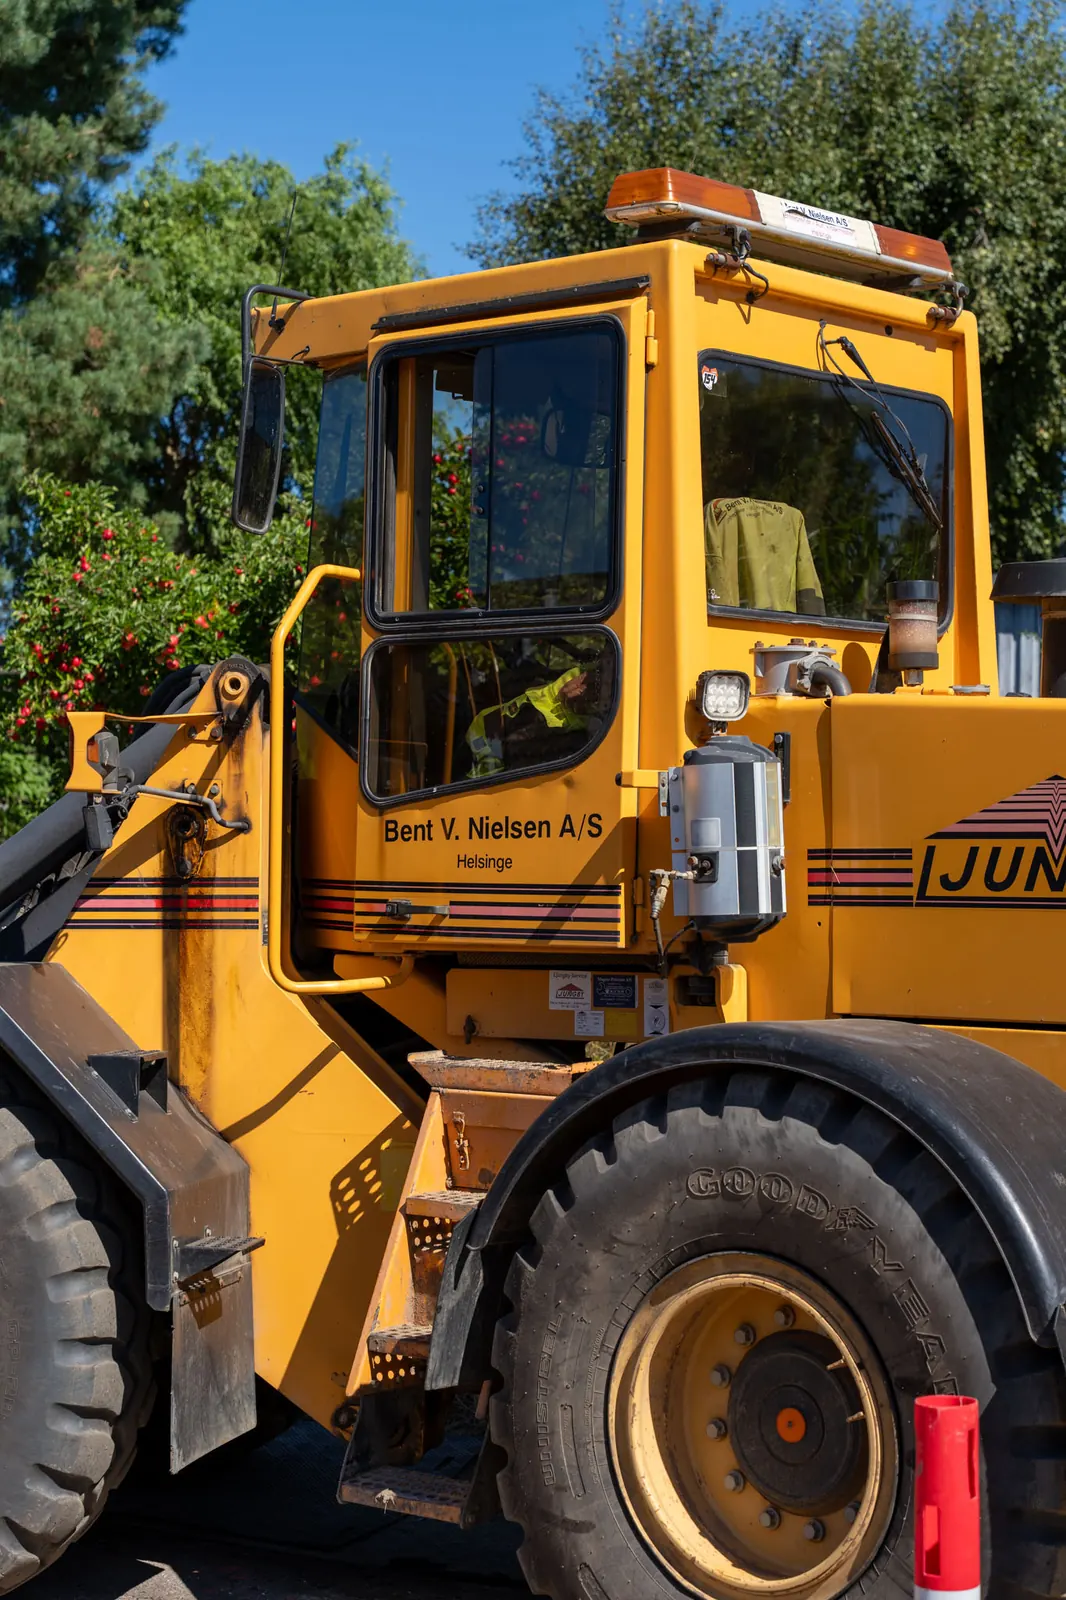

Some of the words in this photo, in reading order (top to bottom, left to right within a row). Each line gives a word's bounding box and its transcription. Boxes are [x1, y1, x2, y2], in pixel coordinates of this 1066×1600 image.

[808, 209, 835, 223] Nielsen
[836, 216, 849, 227] A/S
[703, 373, 716, 385] 154
[384, 819, 433, 842] Bent
[440, 817, 460, 841] V.
[468, 816, 551, 839] Nielsen
[559, 813, 603, 841] A/S
[457, 854, 513, 873] Helsinge
[535, 1312, 564, 1486] UNISTEEL
